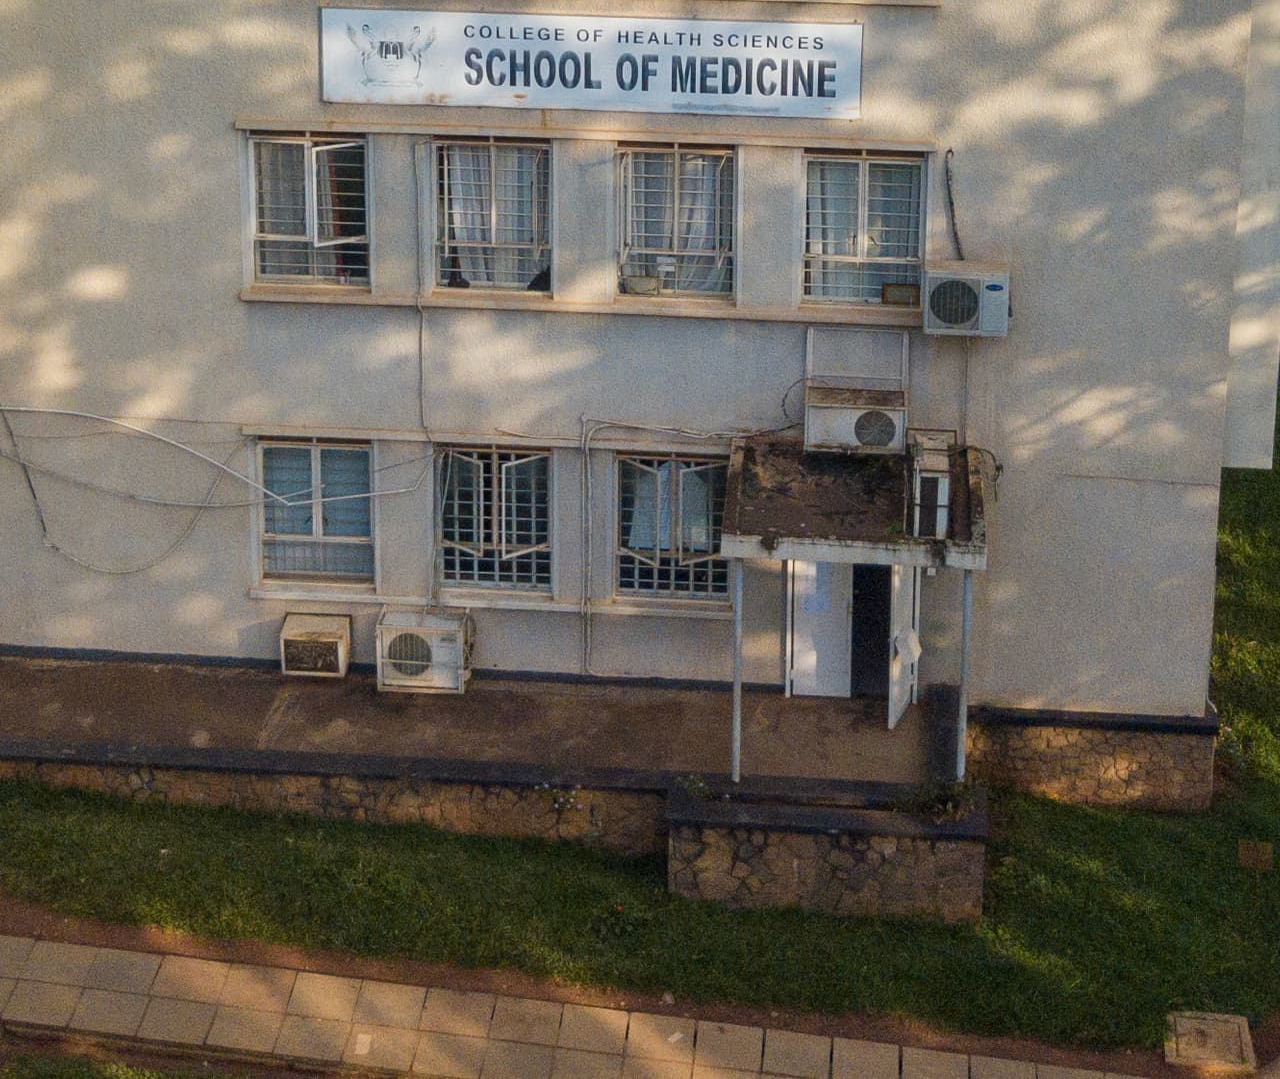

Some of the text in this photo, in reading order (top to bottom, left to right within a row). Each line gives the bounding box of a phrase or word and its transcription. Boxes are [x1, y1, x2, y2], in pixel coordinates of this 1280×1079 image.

[464, 26, 825, 51] COLLEGE OF HEALTH SCIENCES
[465, 48, 837, 99] SCHOOL OF MEDICINE
